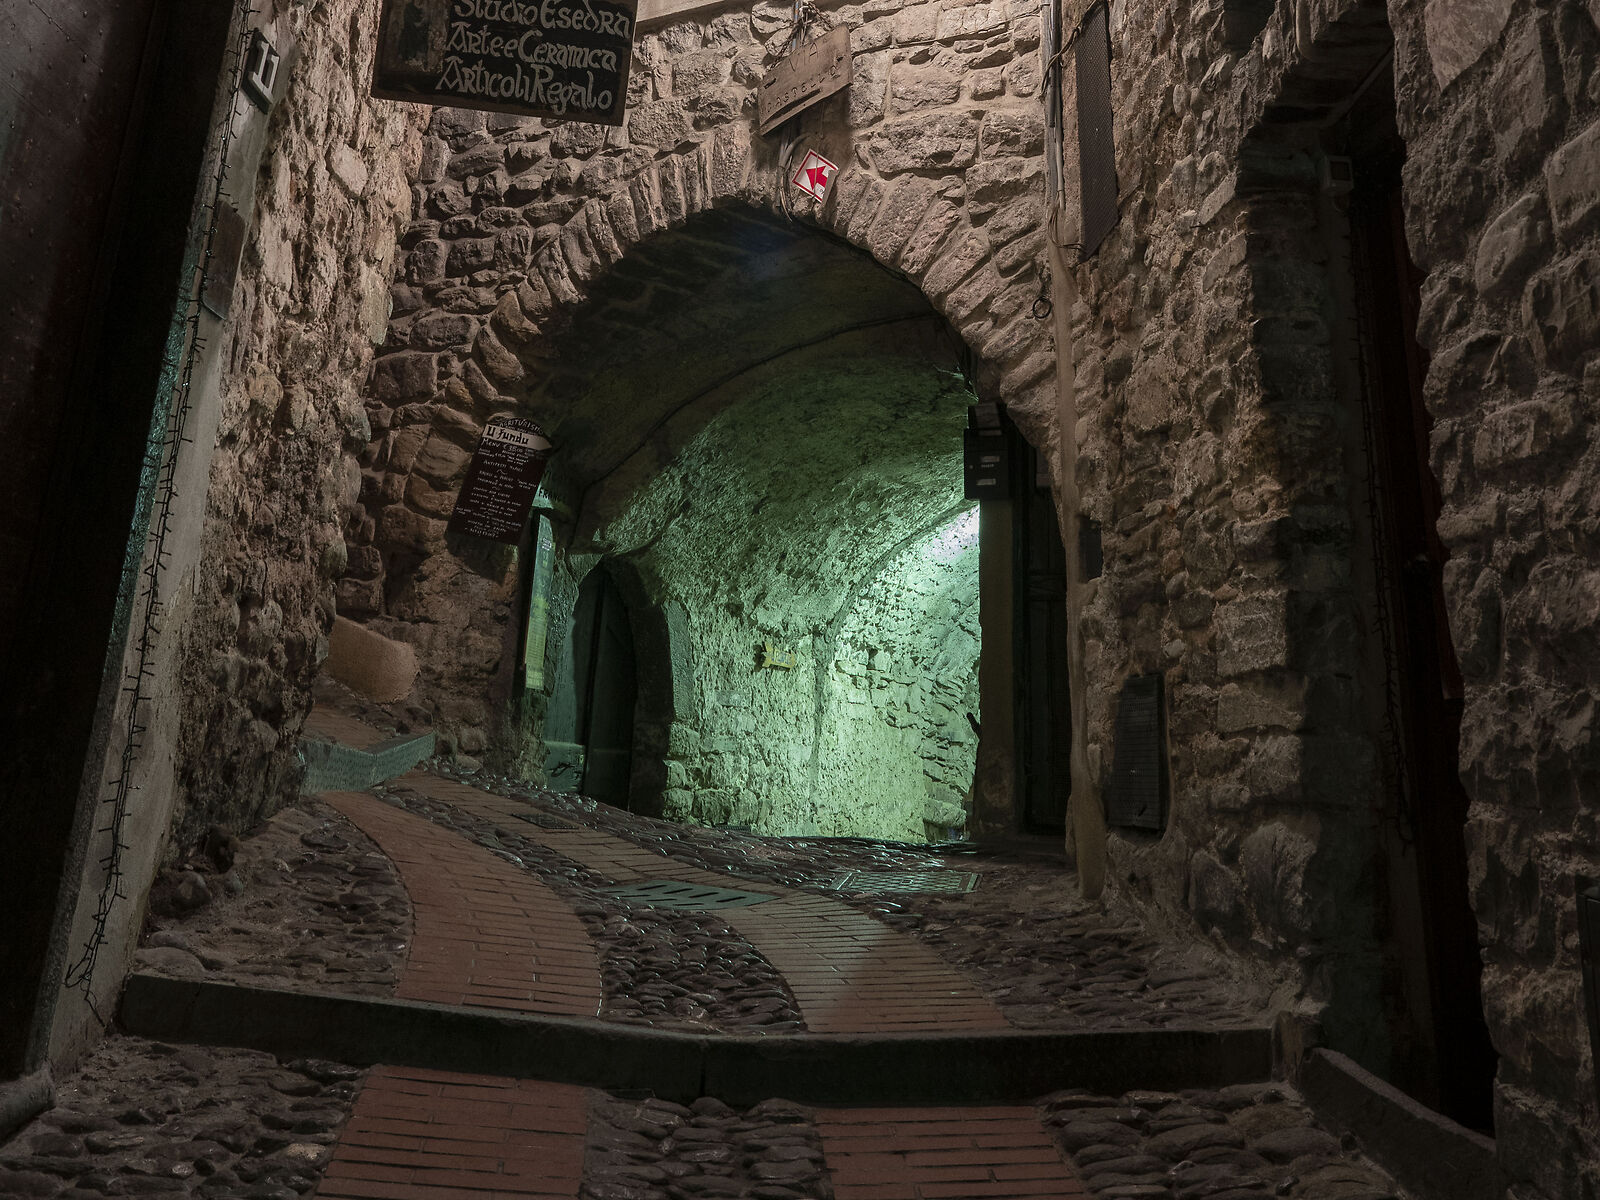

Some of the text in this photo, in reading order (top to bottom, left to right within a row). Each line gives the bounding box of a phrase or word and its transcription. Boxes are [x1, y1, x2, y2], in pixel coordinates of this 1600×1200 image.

[445, 21, 617, 73] Arte e Ceramica
[788, 42, 819, 72] VIA
[435, 56, 613, 116] Articoli Regalo
[766, 64, 841, 113] CASTELLO
